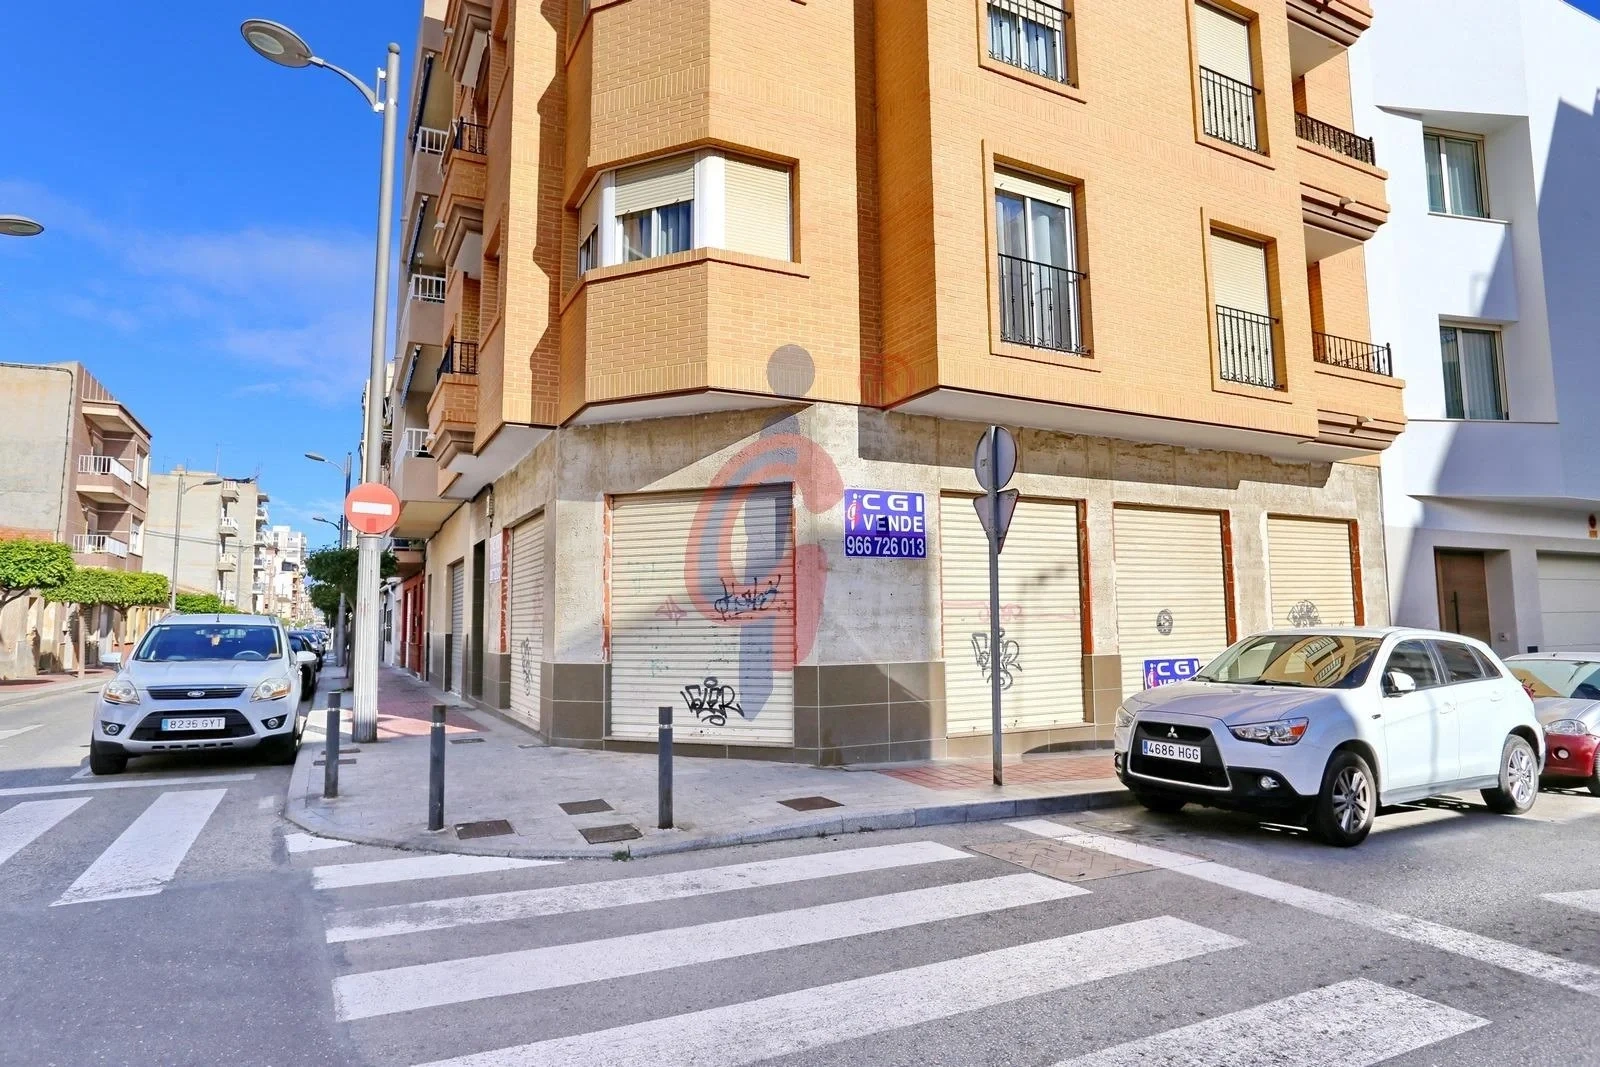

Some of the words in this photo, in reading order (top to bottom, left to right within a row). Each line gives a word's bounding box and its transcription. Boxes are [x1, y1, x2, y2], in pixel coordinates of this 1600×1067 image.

[862, 493, 923, 513] CGI
[862, 513, 924, 533] VENDE
[846, 535, 872, 555] 966
[874, 536, 899, 556] 726
[901, 537, 925, 556] 013
[201, 718, 223, 728] GYT
[1148, 742, 1175, 757] 4686
[1178, 746, 1199, 761] HGG
